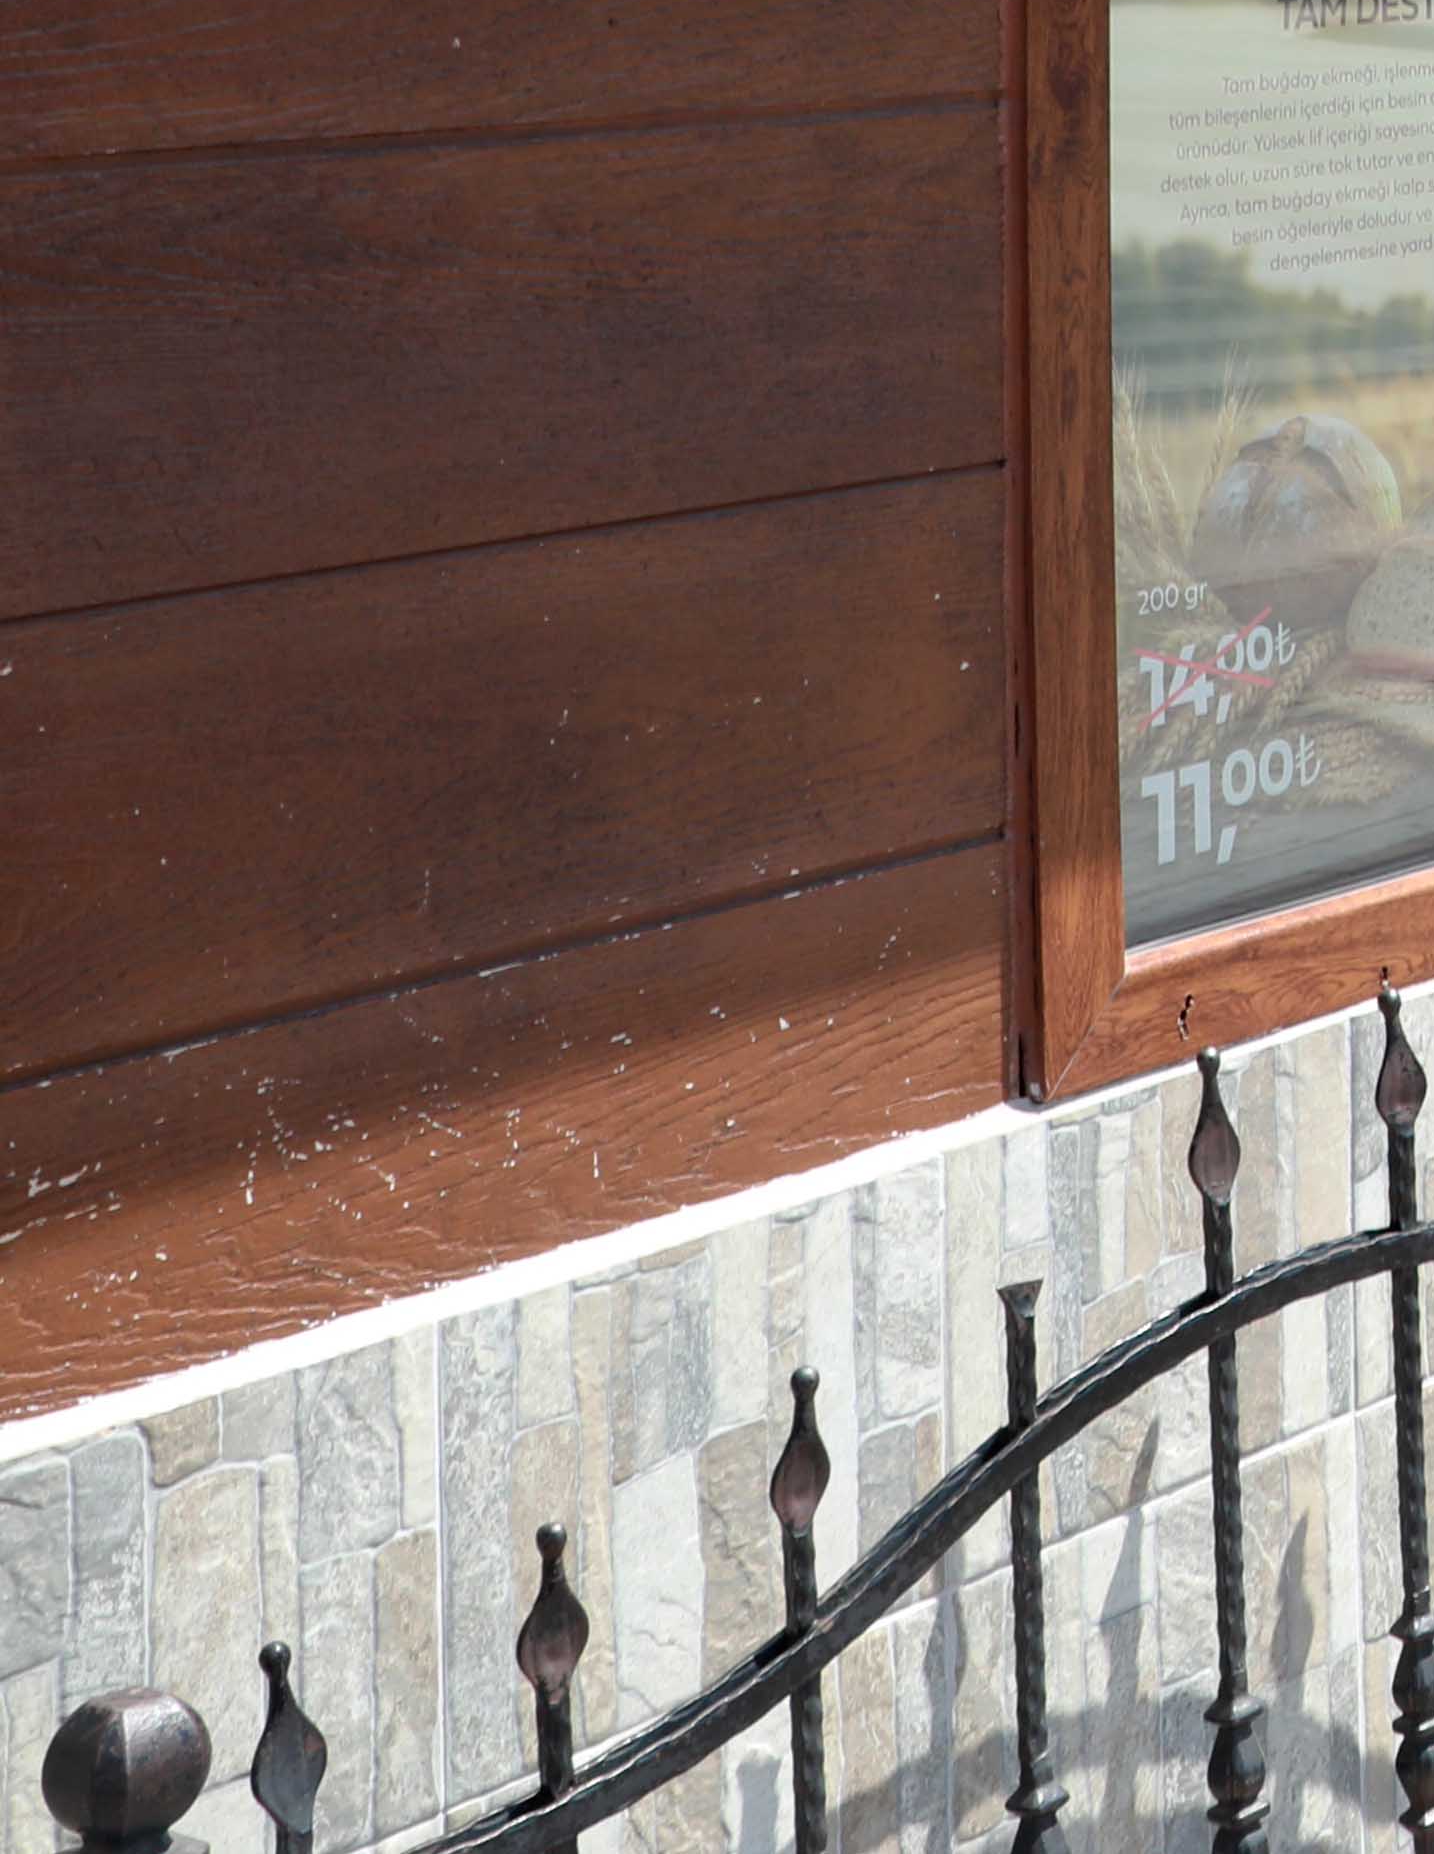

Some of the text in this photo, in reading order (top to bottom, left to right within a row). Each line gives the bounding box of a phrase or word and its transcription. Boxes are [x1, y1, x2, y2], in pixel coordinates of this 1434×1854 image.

[1222, 75, 1256, 95] Tam
[1258, 72, 1320, 98] buğday
[1168, 109, 1202, 131] tüm
[1387, 87, 1428, 111] besin
[1160, 167, 1212, 194] destek
[1328, 154, 1353, 174] tok
[1355, 149, 1396, 171] tutar
[1397, 148, 1415, 167] ve
[1234, 197, 1269, 217] tam
[1270, 189, 1334, 214] buğday
[1231, 227, 1274, 247] besin
[1414, 210, 1434, 224] ve
[1137, 582, 1208, 615] 200 gr
